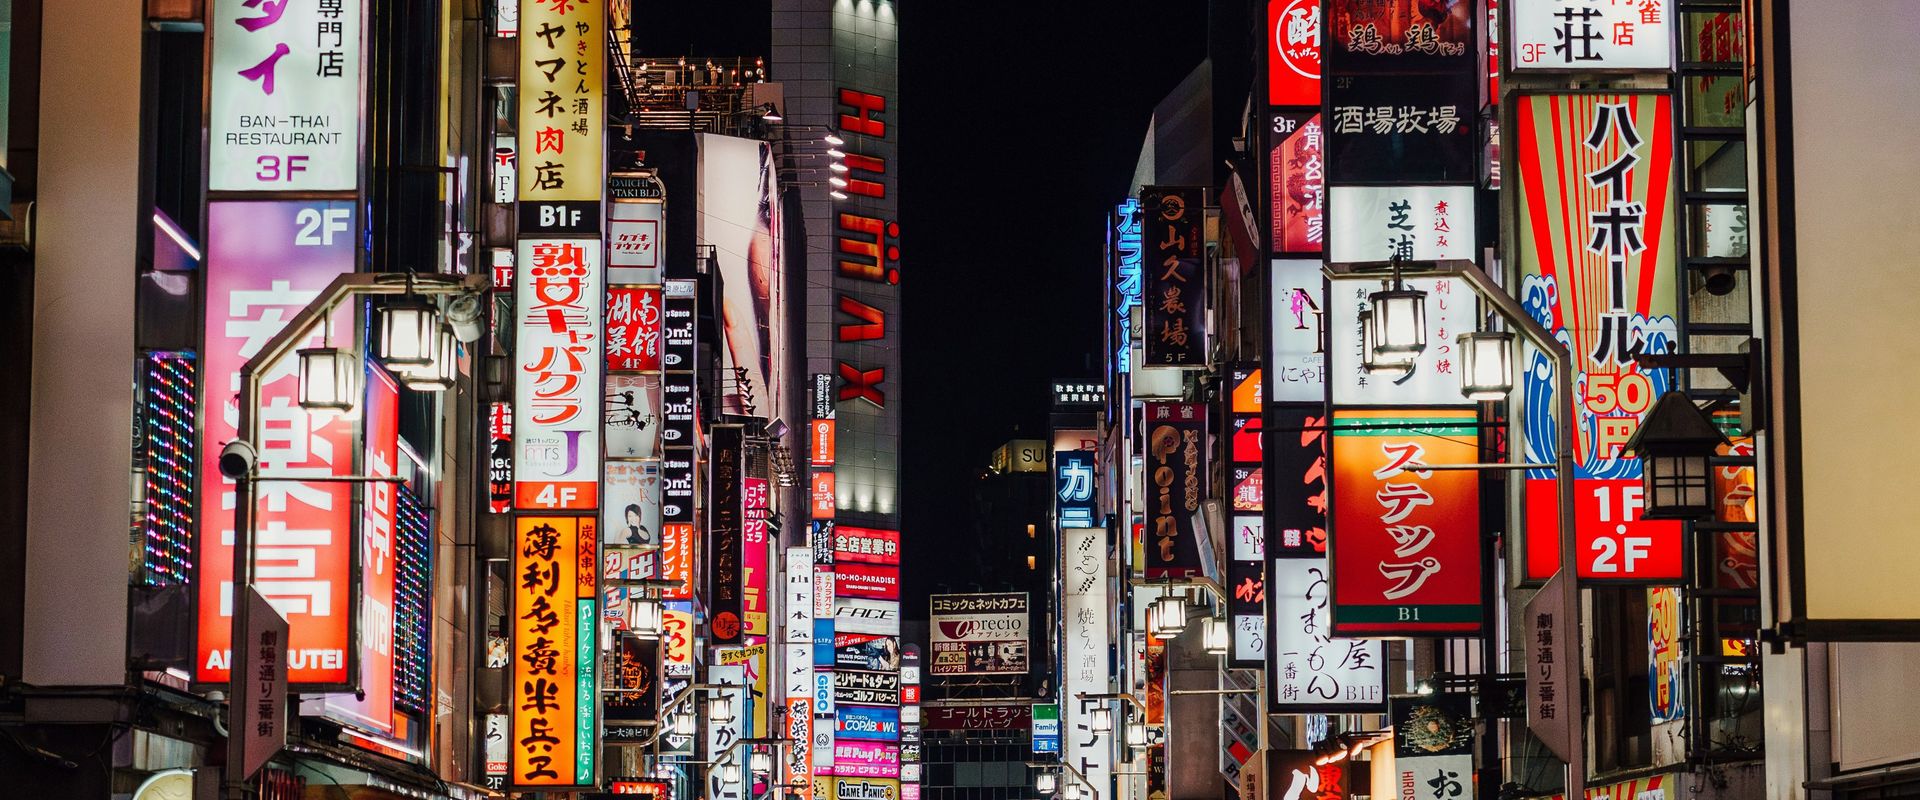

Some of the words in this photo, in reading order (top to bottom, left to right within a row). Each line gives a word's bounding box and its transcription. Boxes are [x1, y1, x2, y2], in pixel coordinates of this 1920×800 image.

[1612, 0, 1634, 46] 店
[1521, 43, 1546, 63] 3F
[571, 21, 590, 137] やきとん酒場
[531, 22, 567, 192] ヤマネ肉店
[240, 115, 330, 128] BAN-THAI
[1273, 120, 1297, 137] 3F
[1333, 105, 1461, 135] 酒場牧場
[226, 132, 342, 145] RESTAURANT
[256, 155, 309, 182] 3F
[295, 208, 350, 246] 2F
[539, 205, 581, 227] B1F
[1582, 102, 1646, 366] ハイボール
[1159, 224, 1189, 347] 山久農場
[621, 358, 642, 369] 4F
[1587, 372, 1651, 415] 50
[1155, 406, 1194, 420] 麻雀
[1234, 419, 1246, 428] 4F
[1235, 470, 1249, 479] 3F
[535, 484, 578, 508] 4F
[1592, 485, 1645, 522] 1F
[1372, 441, 1442, 602] ステップ
[578, 525, 595, 588] 炭火串焼
[836, 536, 897, 556] 全店営業中
[1591, 536, 1652, 573] 2F
[662, 526, 676, 598] リフレッュ
[836, 573, 896, 585] MO-MO-PARADISE
[836, 606, 897, 620] FACE
[933, 598, 1026, 612] コミック&ネットカフェ
[1397, 607, 1420, 622] B1
[1077, 607, 1097, 682] 焼とん酒場
[1282, 651, 1300, 702] 一番街
[1536, 612, 1556, 720] 劇場通り一番街
[257, 629, 277, 738] 劇場通り一番街
[1345, 685, 1380, 701] B1F
[853, 690, 876, 702] ゴルフ
[962, 721, 1014, 733] ハンバーグ
[486, 776, 504, 790] 2F
